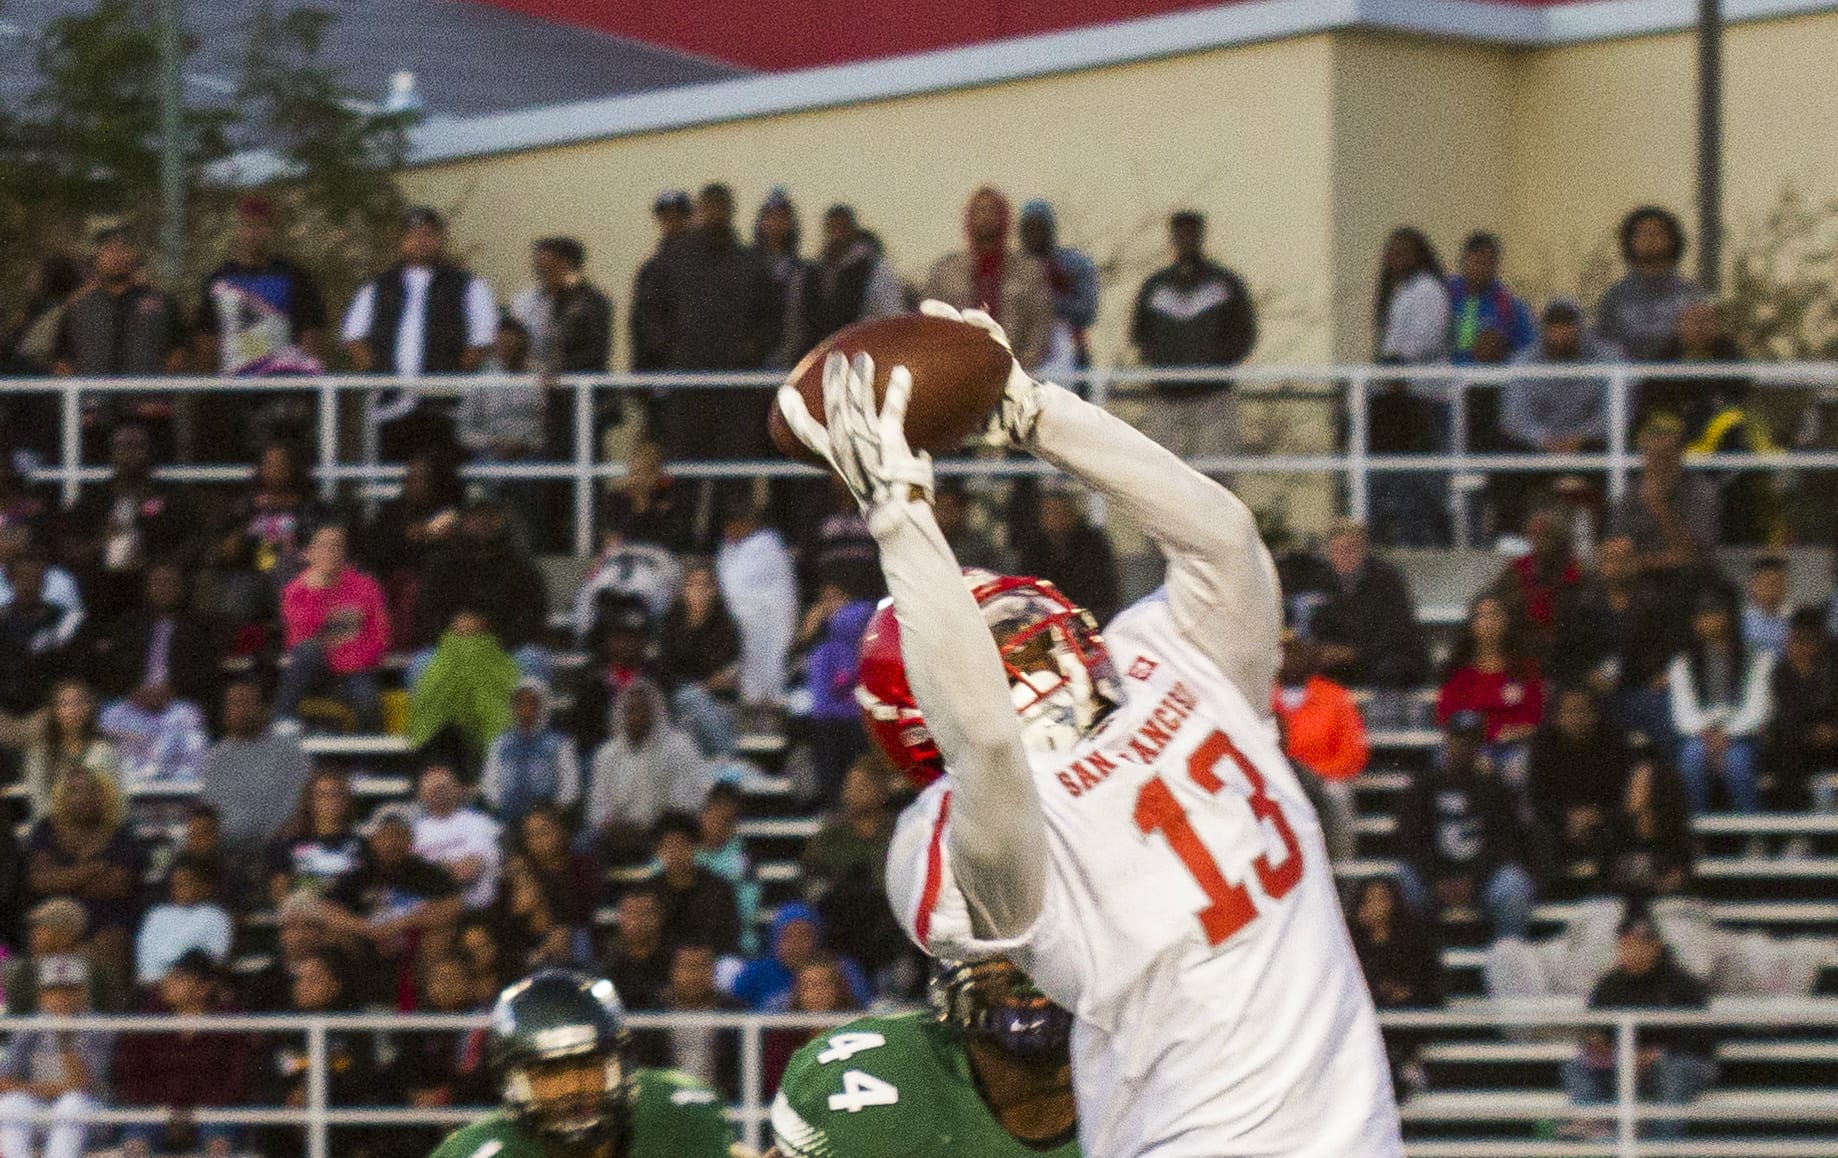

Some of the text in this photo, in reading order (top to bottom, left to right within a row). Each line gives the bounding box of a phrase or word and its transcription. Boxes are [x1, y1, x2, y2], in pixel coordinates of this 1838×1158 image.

[1055, 751, 1118, 798] SAN
[1132, 728, 1304, 947] 13
[816, 1030, 900, 1113] 44
